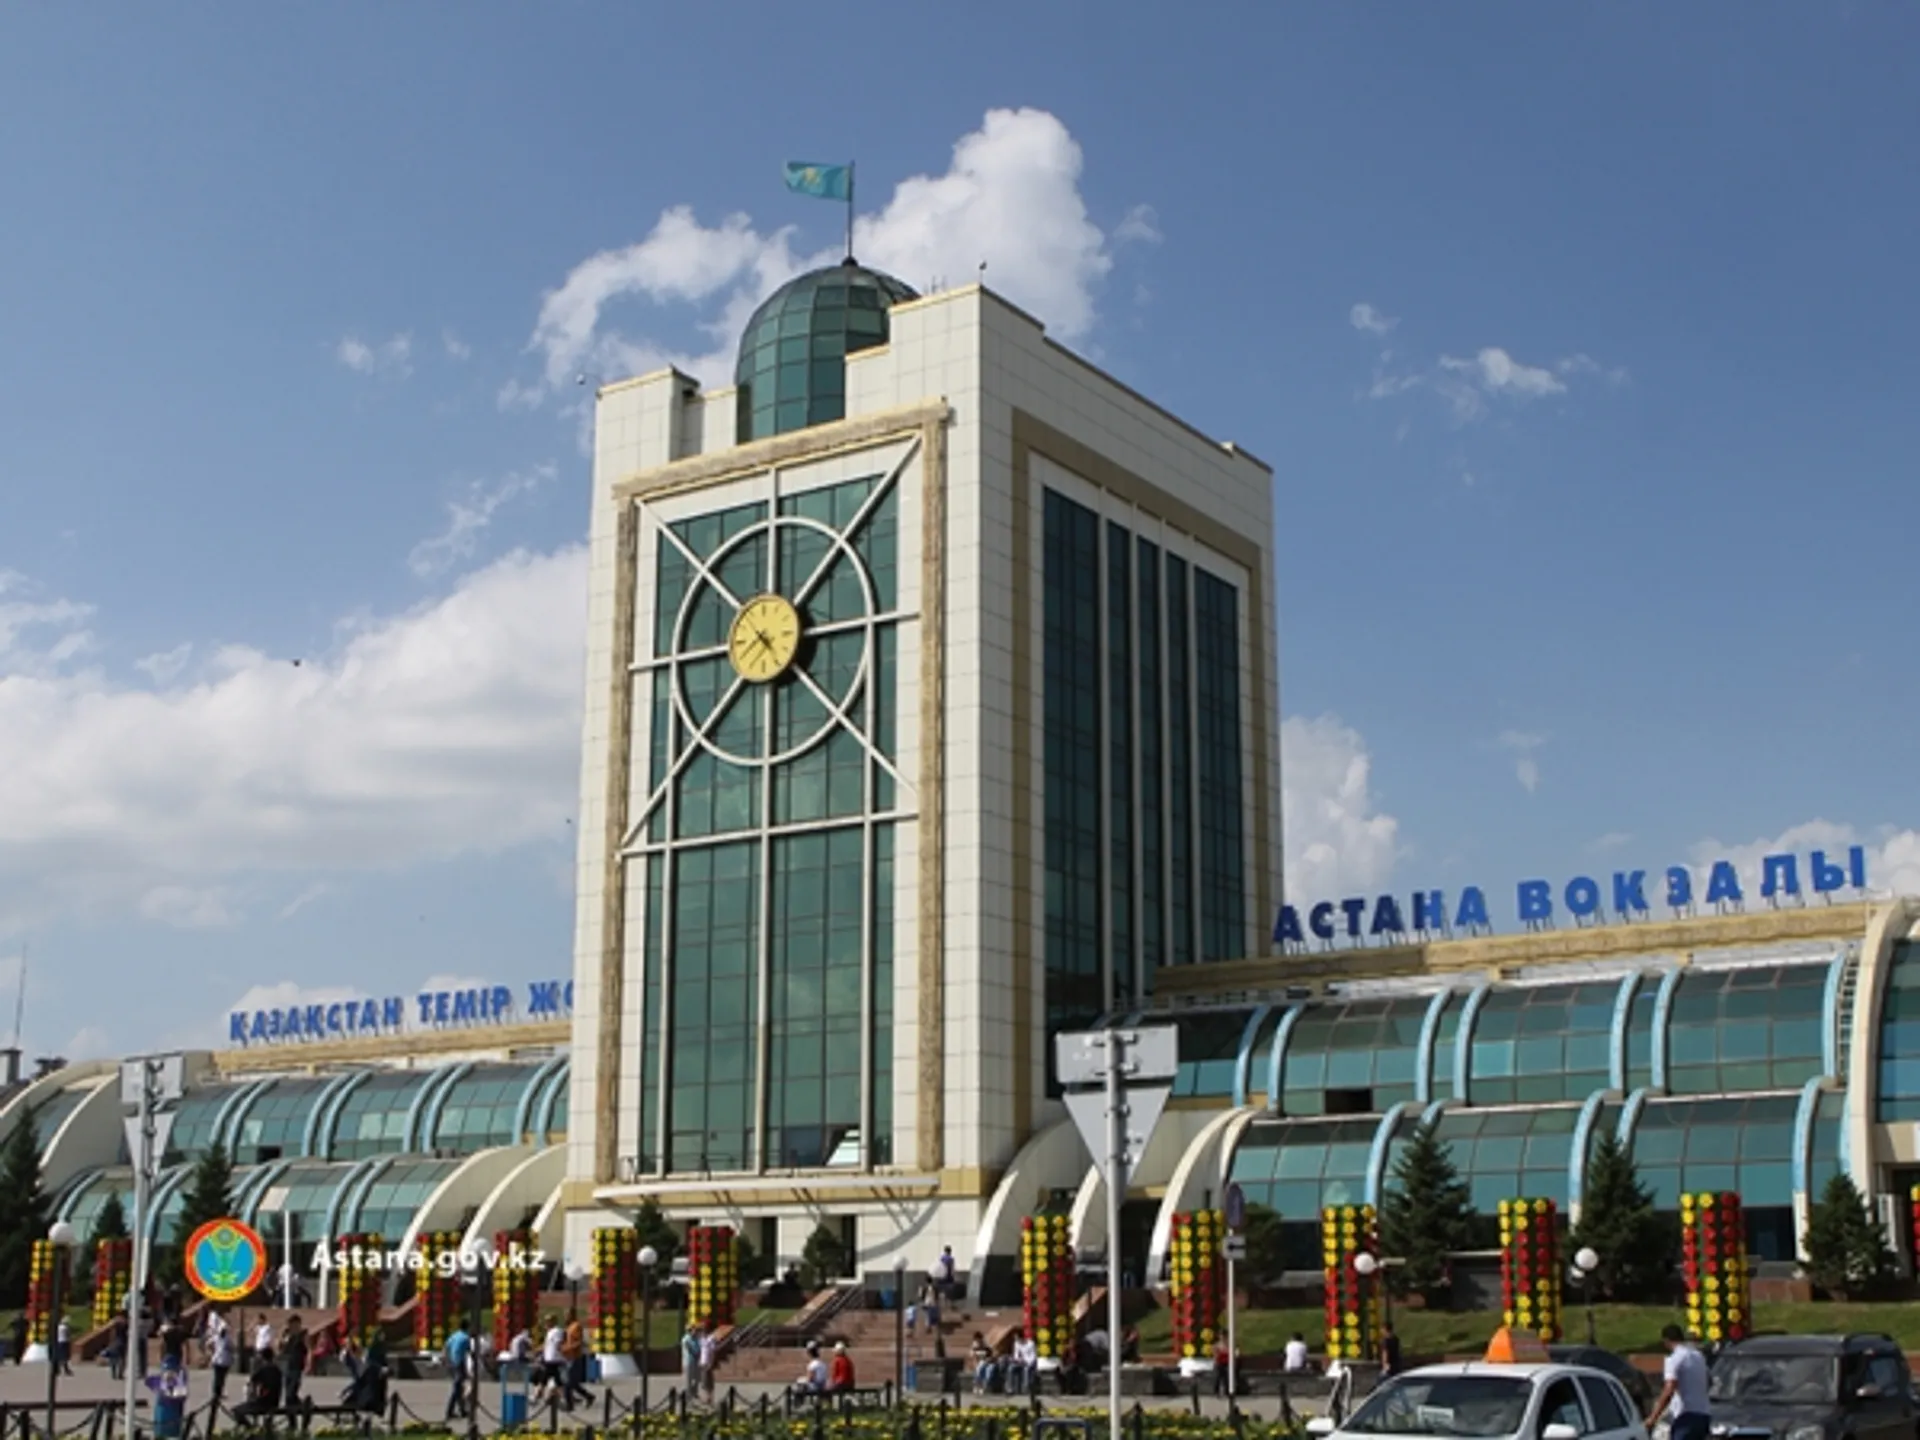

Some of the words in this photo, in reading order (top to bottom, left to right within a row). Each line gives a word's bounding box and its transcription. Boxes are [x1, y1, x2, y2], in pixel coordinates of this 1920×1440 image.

[1272, 885, 1490, 943] АСТАНА
[1517, 846, 1865, 921] ВОКЗАЛЫ
[229, 997, 404, 1046] ҚАЗАҚСТАН
[417, 986, 512, 1023] ТЕМІР
